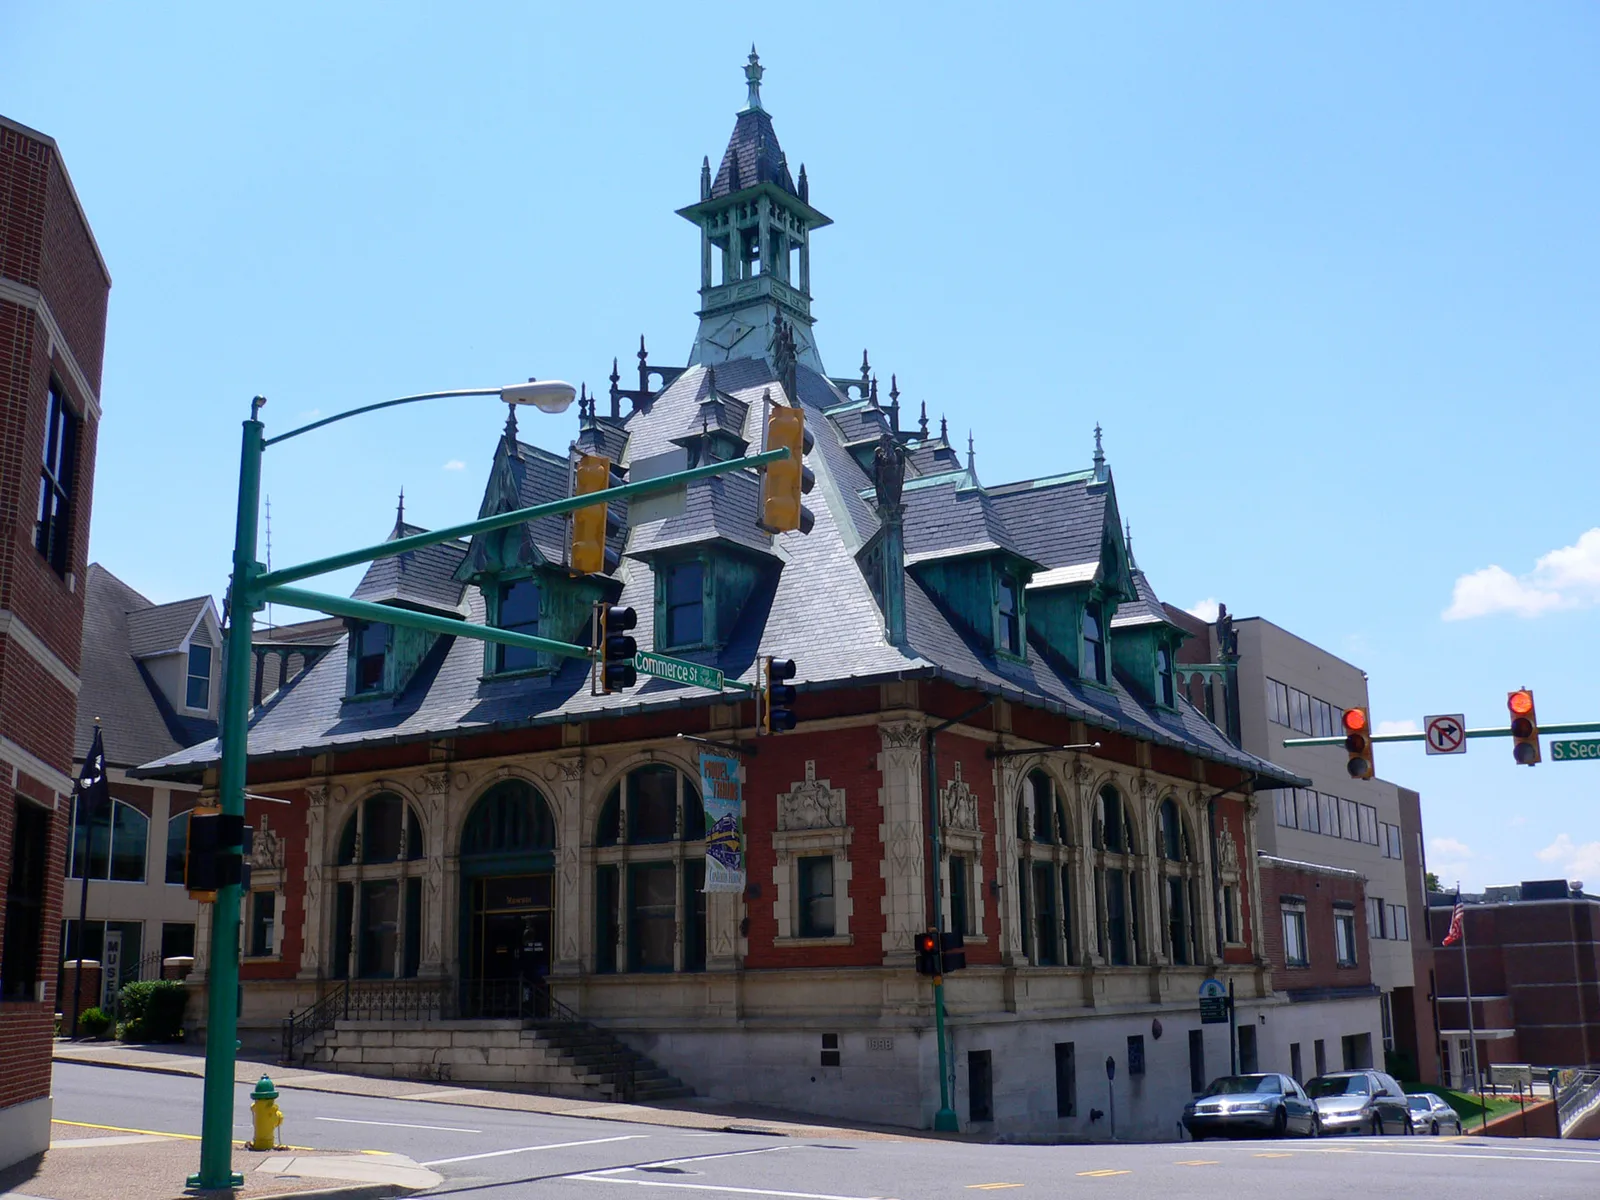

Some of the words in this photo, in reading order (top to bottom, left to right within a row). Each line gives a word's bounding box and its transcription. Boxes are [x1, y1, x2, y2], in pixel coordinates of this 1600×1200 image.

[634, 651, 688, 681] Commerce
[689, 667, 698, 682] St
[103, 940, 119, 1017] MUSEUM
